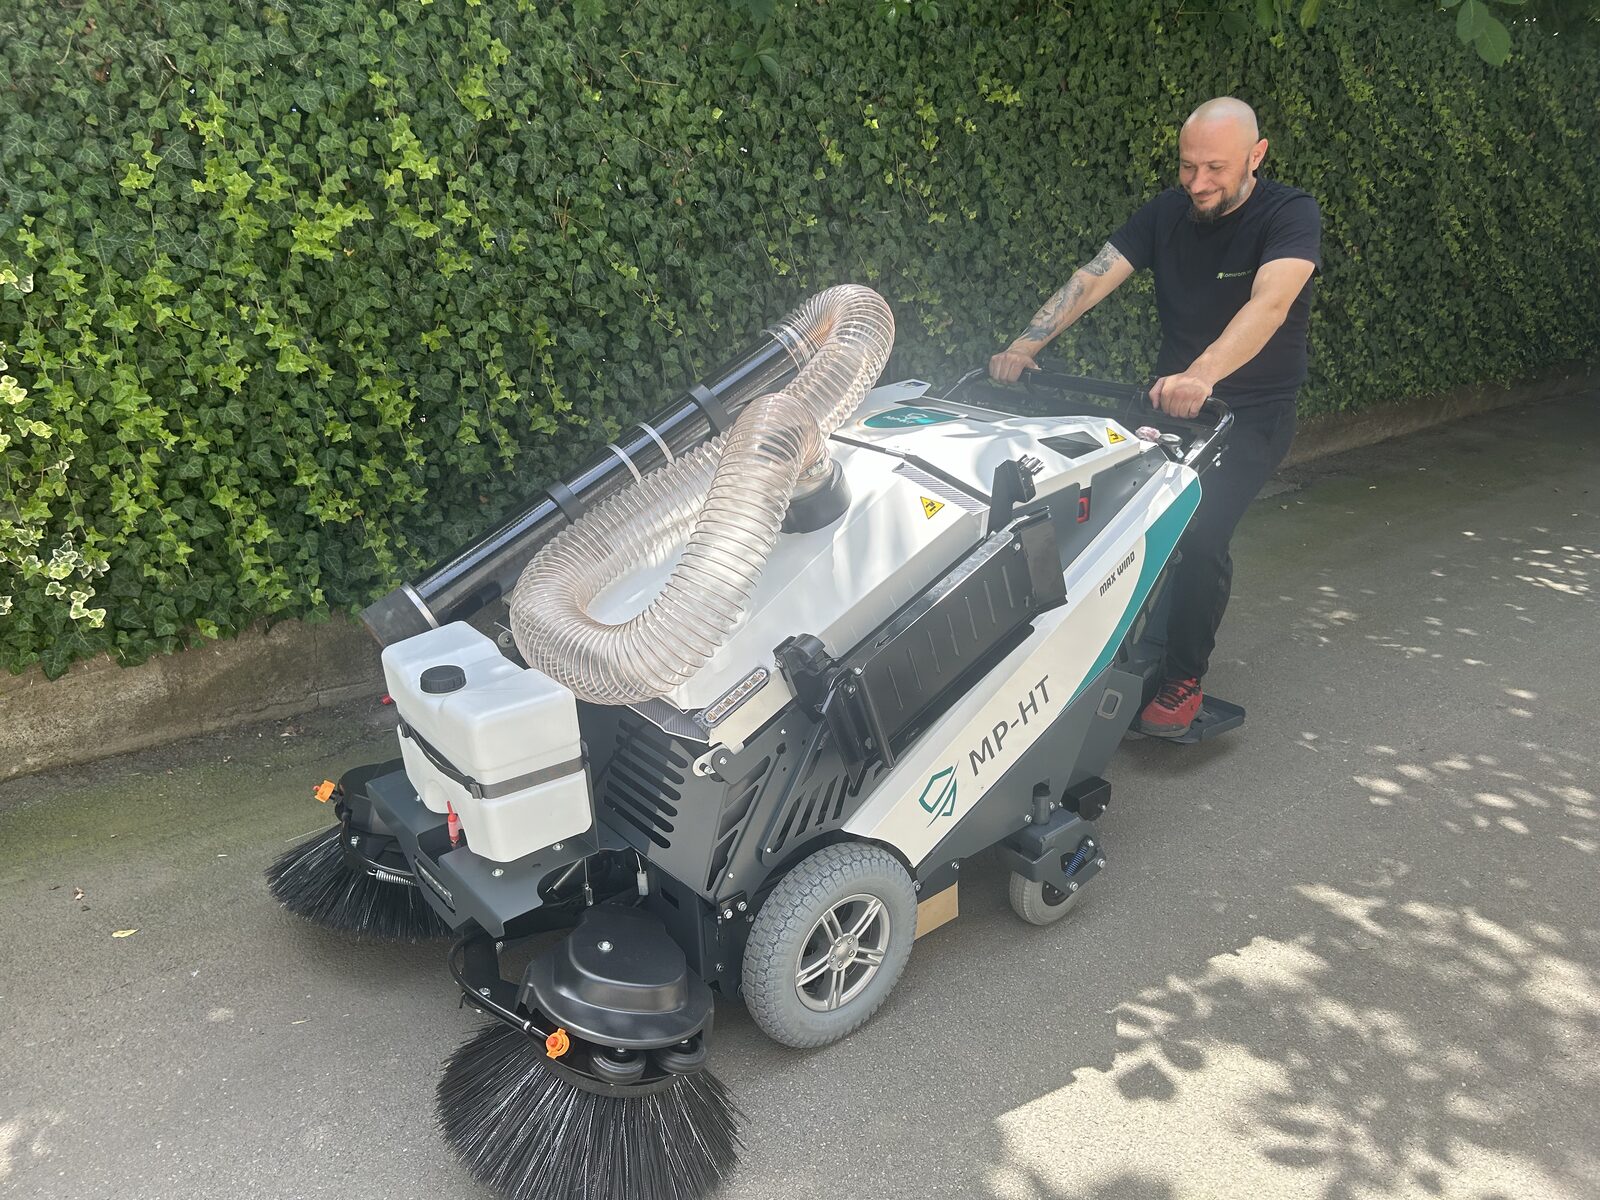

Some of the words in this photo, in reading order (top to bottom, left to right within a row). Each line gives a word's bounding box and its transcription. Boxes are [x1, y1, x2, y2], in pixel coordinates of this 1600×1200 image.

[1099, 572, 1116, 597] MAX
[1116, 551, 1135, 576] WIND
[968, 674, 1050, 777] MP-HT
